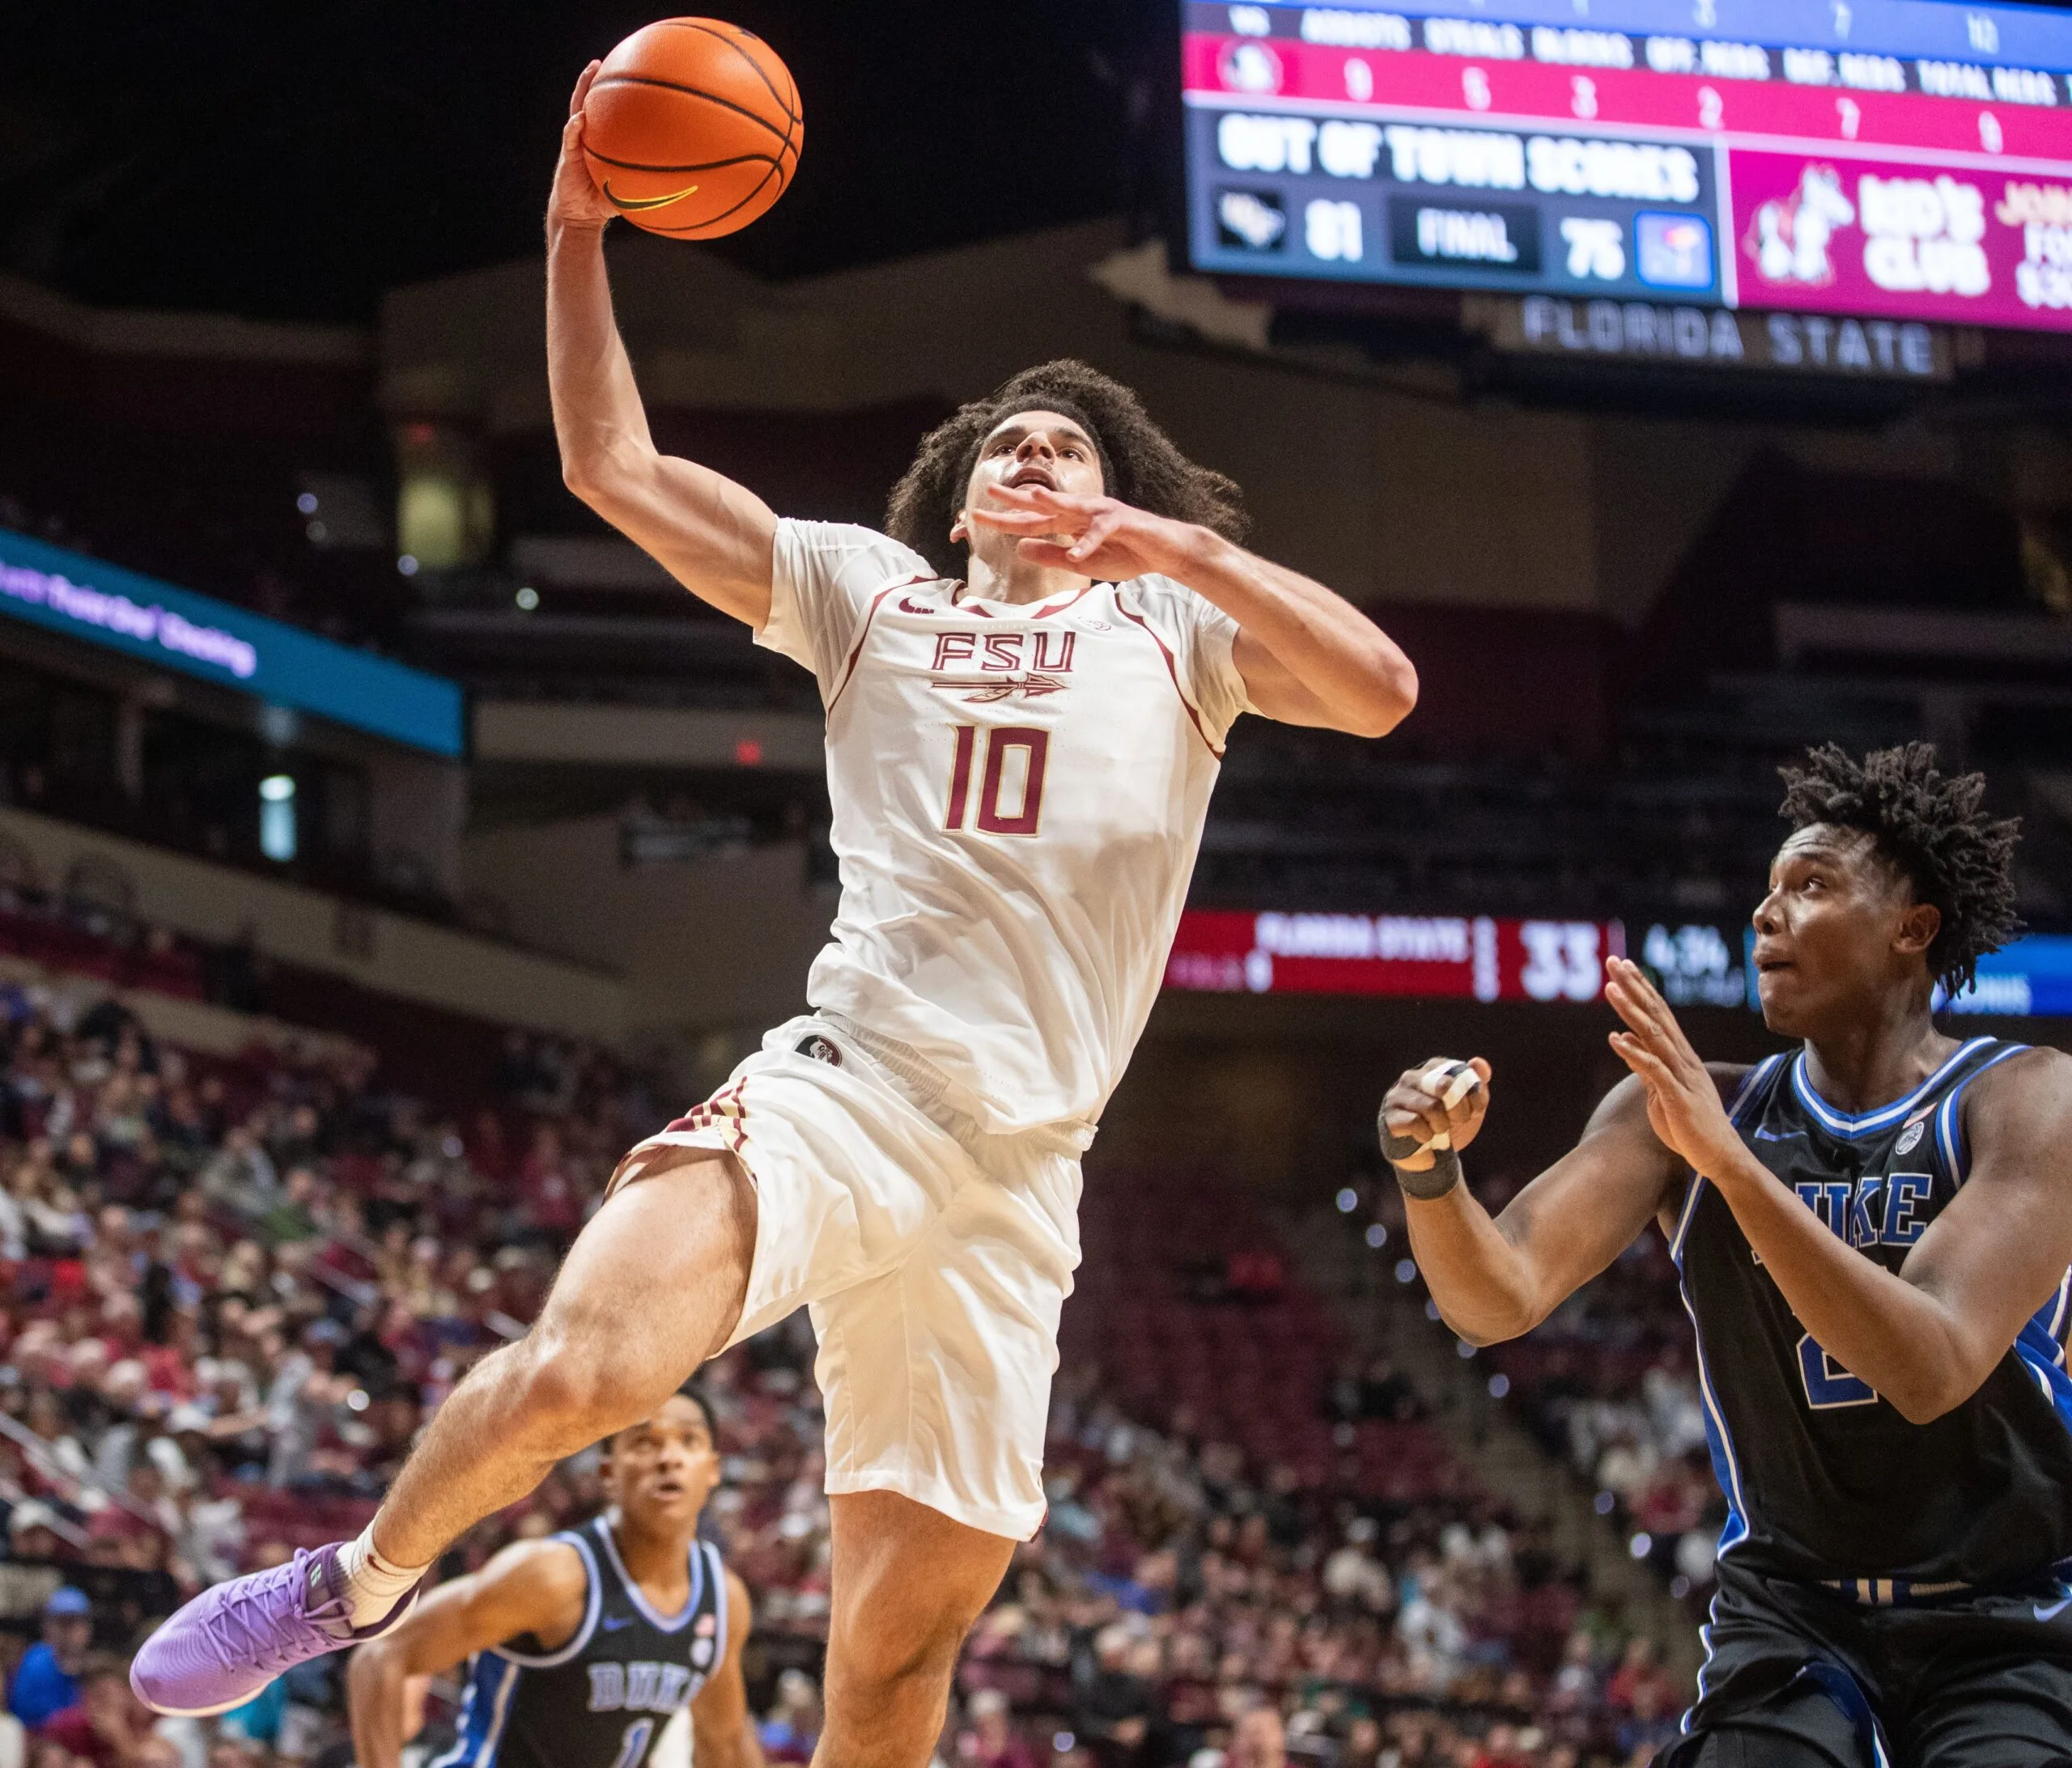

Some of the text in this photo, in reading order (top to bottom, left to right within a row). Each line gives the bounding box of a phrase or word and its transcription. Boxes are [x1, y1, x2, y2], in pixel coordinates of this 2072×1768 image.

[1697, 85, 1726, 130] 2
[1218, 113, 1698, 203] OUT OF TOWN SCORES
[1417, 208, 1518, 262] FINAL
[1864, 236, 1991, 295] CLUB
[1523, 295, 1933, 375] FLORIDA STATE
[931, 631, 1076, 672] FSU
[940, 723, 1051, 838] 10
[1519, 920, 1602, 1001] 33
